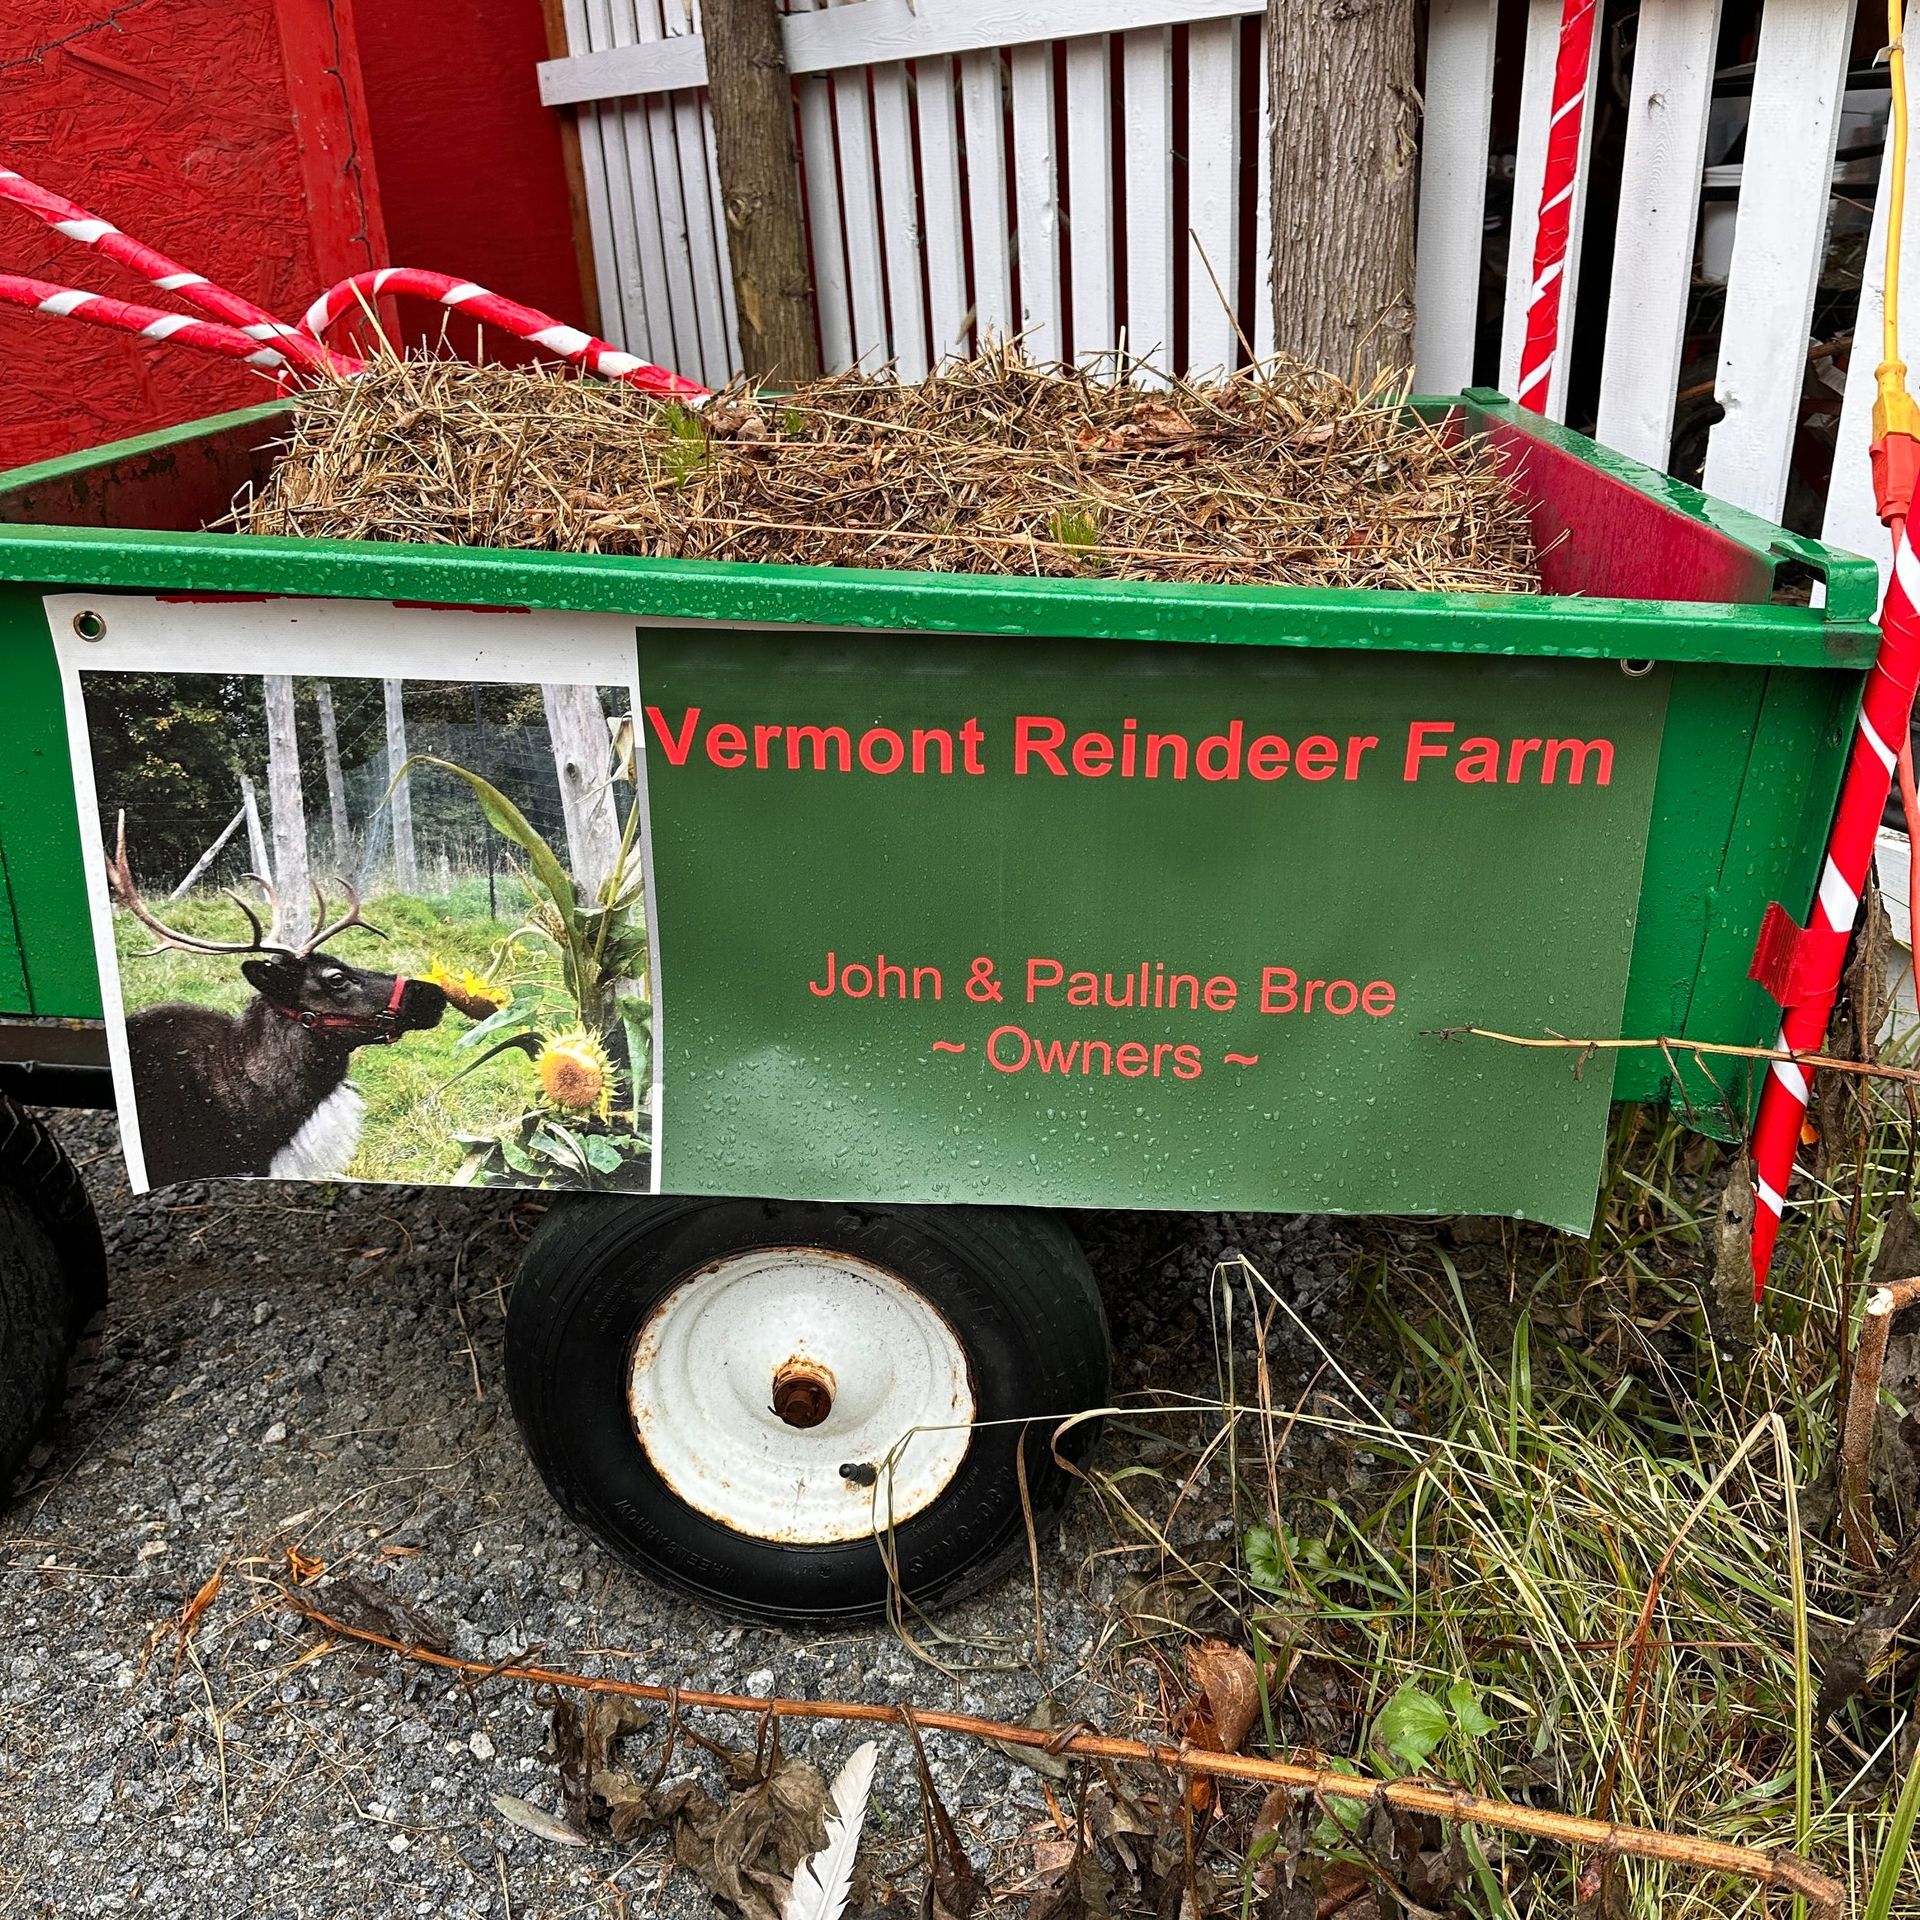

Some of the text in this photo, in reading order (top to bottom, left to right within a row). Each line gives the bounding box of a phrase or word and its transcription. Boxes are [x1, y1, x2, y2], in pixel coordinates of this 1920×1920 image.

[645, 705, 1615, 786] Vermont Reindeer Farm
[809, 952, 1397, 1017] John & Pauline Broe
[987, 1025, 1202, 1081] Owners
[834, 1215, 1002, 1326] CARLISLE
[614, 1498, 736, 1578] WHEELBARROW
